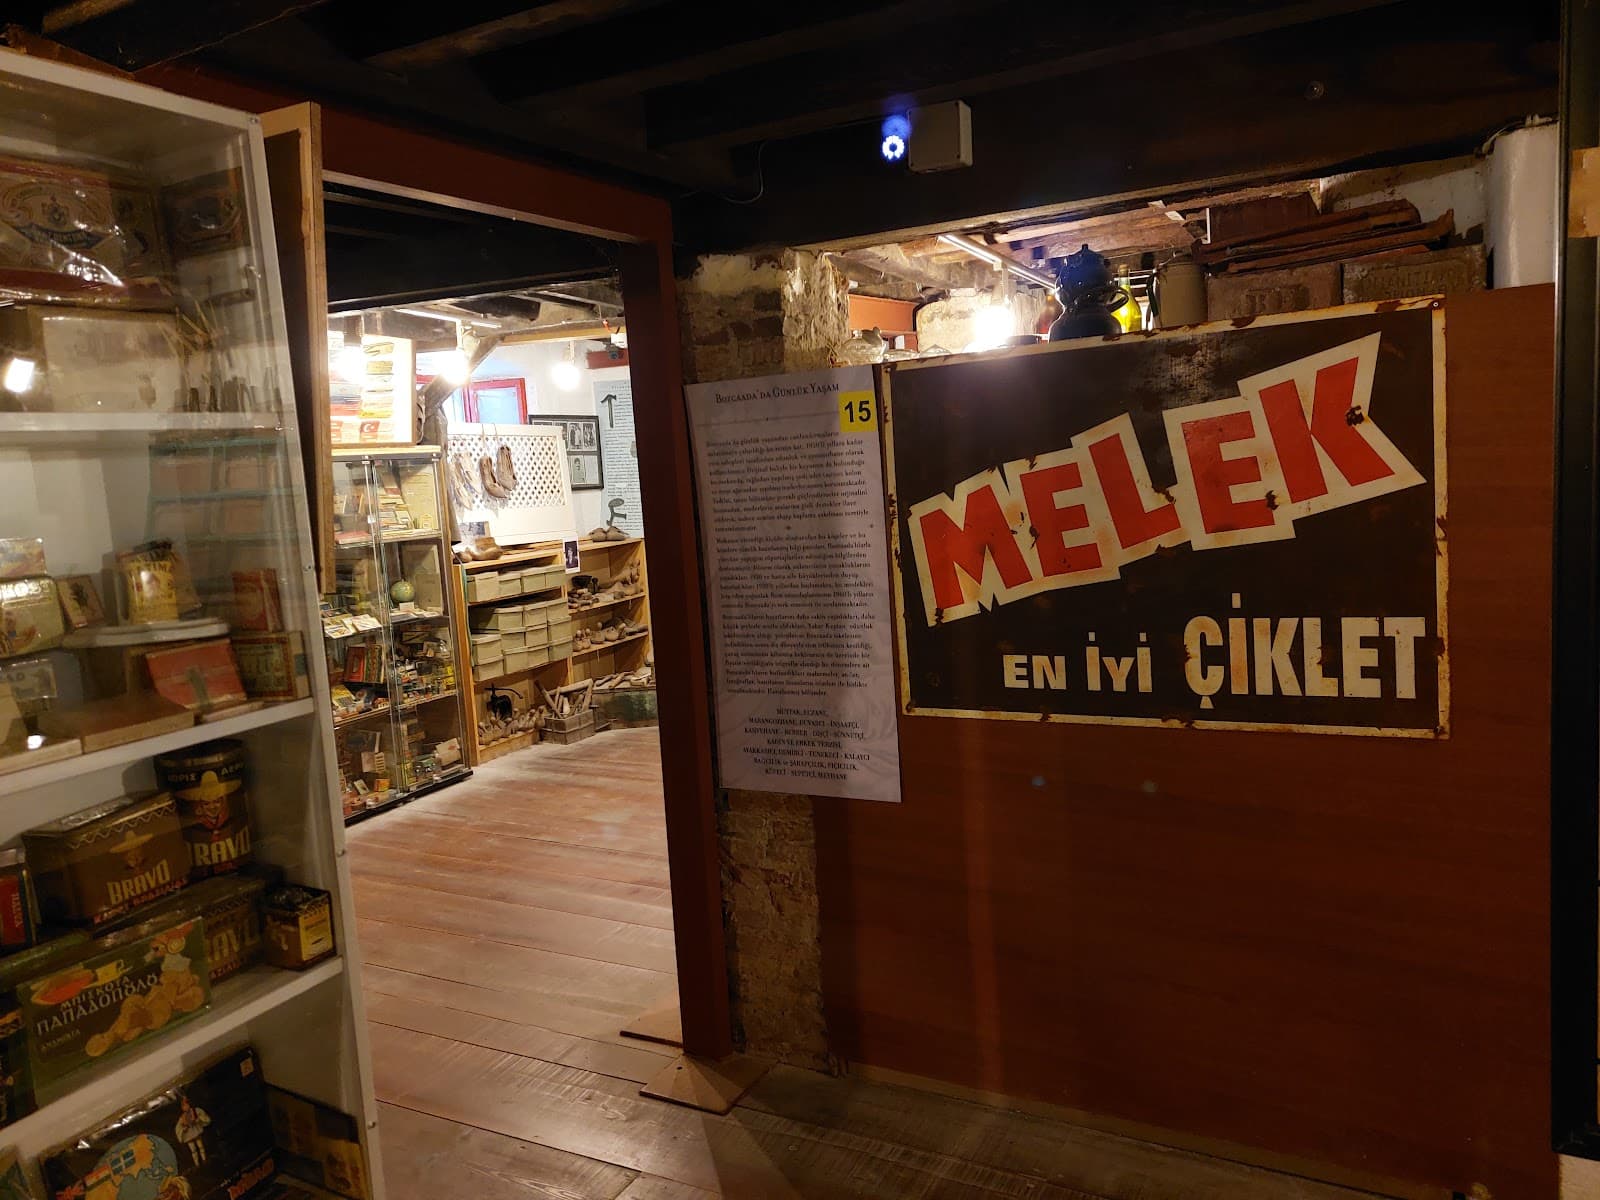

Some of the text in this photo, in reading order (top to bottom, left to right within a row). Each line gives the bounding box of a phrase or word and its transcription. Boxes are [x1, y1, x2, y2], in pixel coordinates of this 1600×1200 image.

[844, 400, 872, 423] 15
[914, 353, 1398, 612] MELEK
[1002, 654, 1067, 690] EN
[1182, 592, 1426, 709] ÇİKLET
[105, 858, 171, 905] BRAVO
